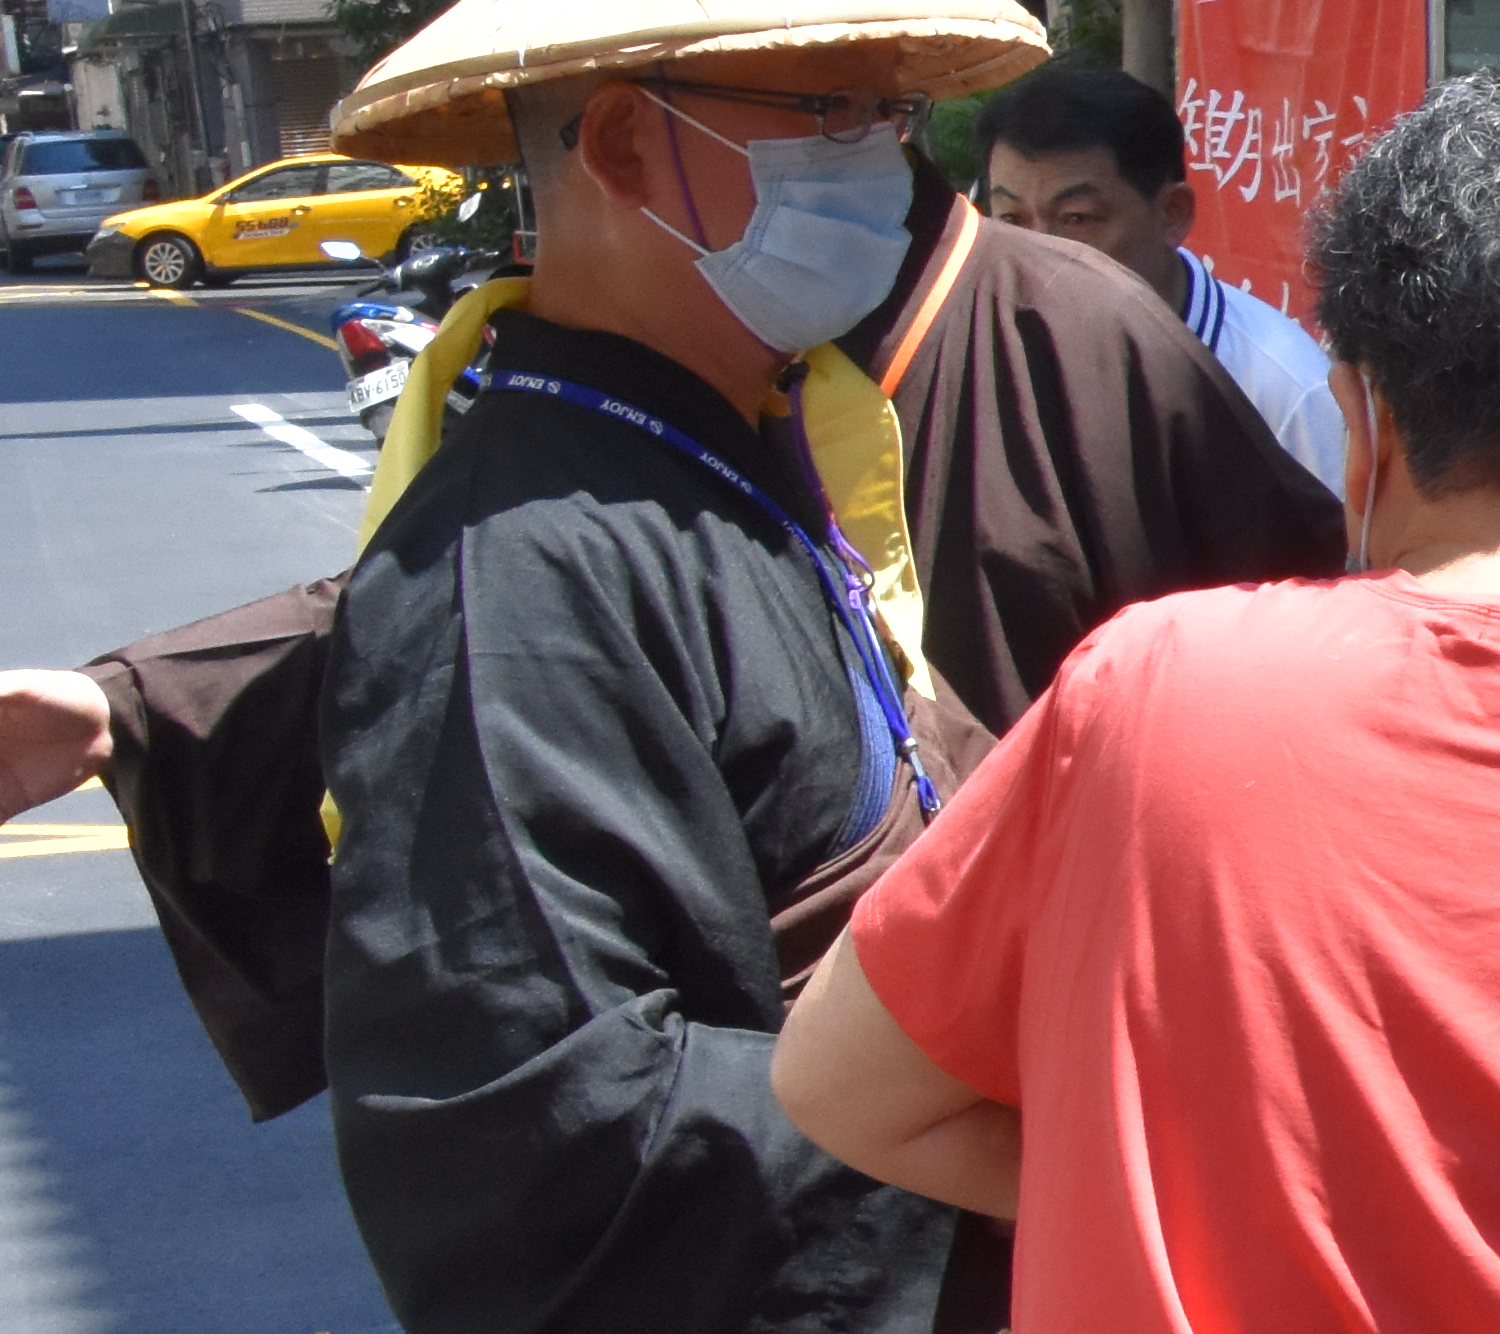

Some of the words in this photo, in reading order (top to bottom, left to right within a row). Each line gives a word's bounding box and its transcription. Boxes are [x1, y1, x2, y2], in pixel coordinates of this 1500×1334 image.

[508, 374, 546, 390] ENJOY
[600, 399, 648, 426] ENJOY
[700, 452, 739, 482] ENJOY
